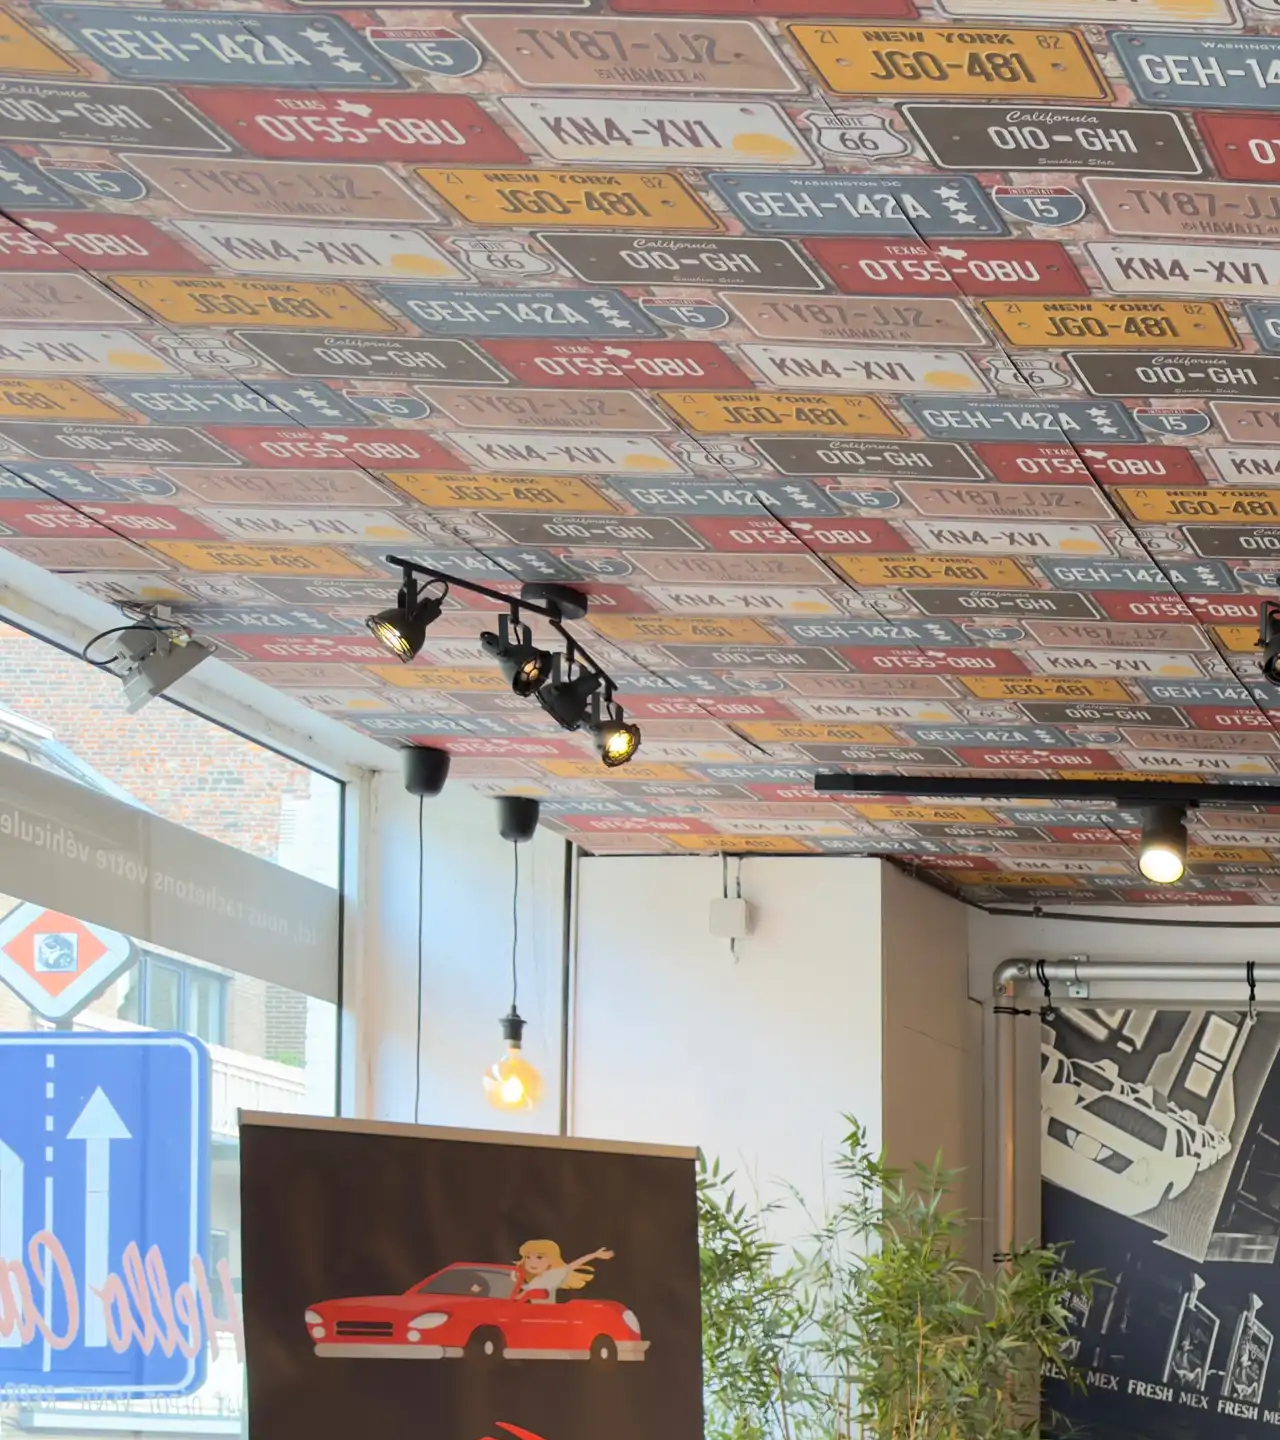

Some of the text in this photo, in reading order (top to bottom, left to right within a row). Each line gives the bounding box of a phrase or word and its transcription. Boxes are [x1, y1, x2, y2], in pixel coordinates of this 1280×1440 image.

[863, 32, 1014, 44] NEW YORK
[406, 42, 454, 66] 15
[998, 107, 1097, 125] California
[833, 131, 883, 152] 66
[74, 172, 122, 192] 15
[735, 188, 932, 222] GEH-142A
[1023, 198, 1059, 217] 15
[479, 253, 530, 271] 66
[1086, 1370, 1120, 1392] MEX
[1127, 1379, 1173, 1403] FRESH
[1178, 1391, 1209, 1410] MEX
[1217, 1399, 1259, 1421] FRESH
